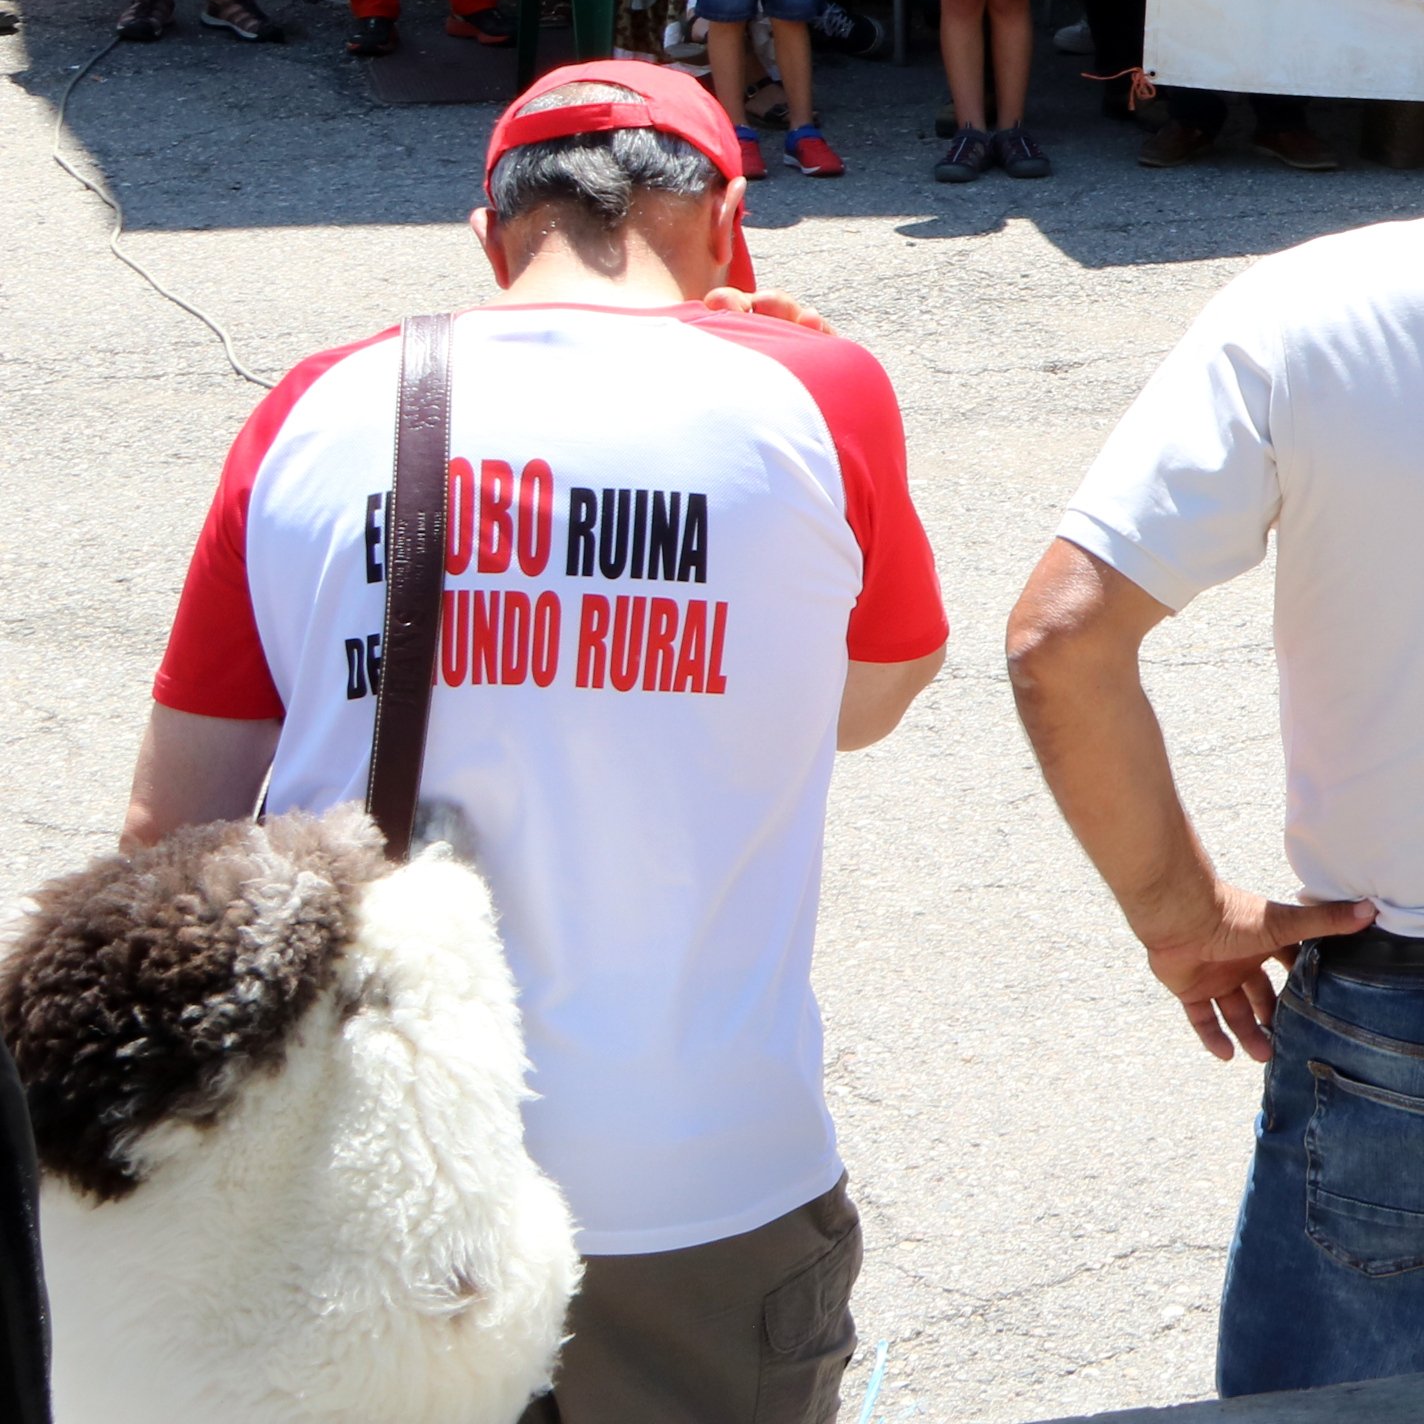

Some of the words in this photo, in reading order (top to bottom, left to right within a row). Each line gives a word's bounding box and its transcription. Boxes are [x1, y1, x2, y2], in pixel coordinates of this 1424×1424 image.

[445, 456, 554, 577] OBO
[566, 487, 708, 583] RUINA
[345, 632, 383, 700] DE
[432, 589, 562, 688] UNDO
[575, 592, 729, 695] RURAL
